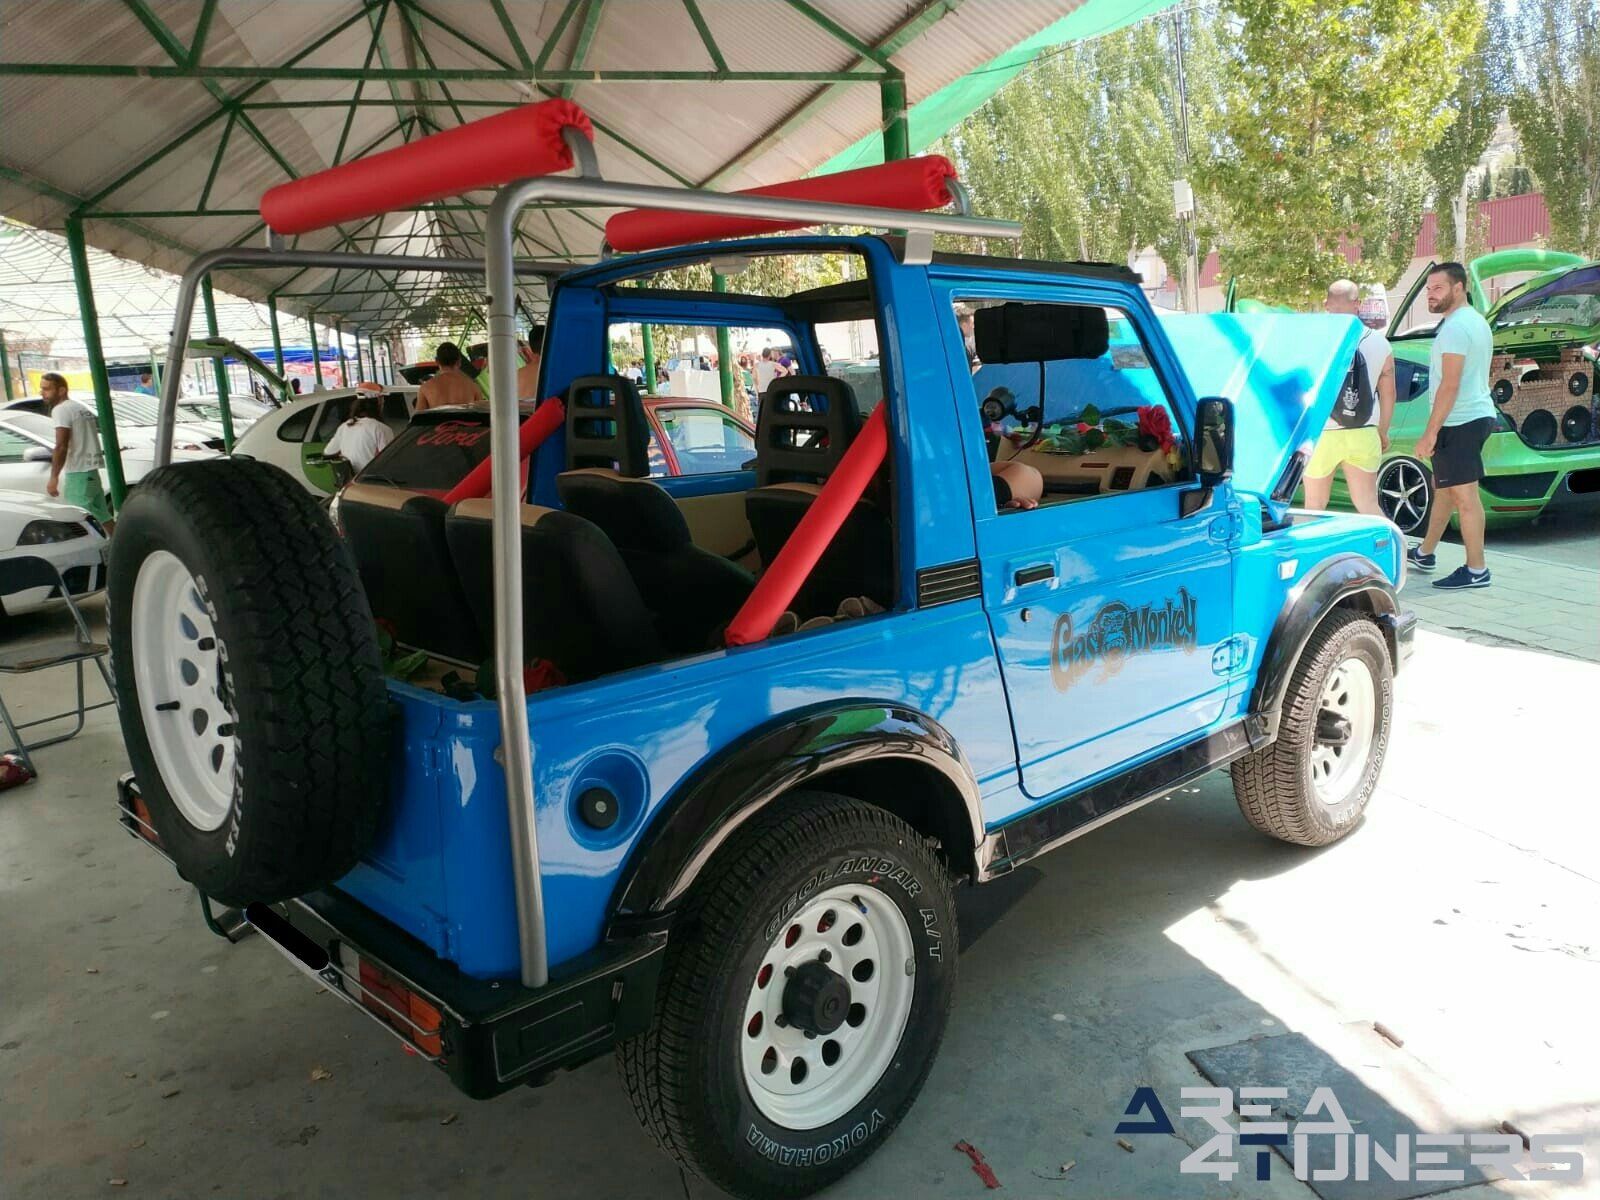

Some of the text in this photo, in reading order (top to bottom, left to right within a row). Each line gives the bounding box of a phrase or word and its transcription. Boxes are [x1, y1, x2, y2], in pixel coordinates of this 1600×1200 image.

[416, 420, 490, 447] Ford
[1052, 586, 1197, 693] Gas Monkey
[765, 856, 944, 963] GEOLANDAR A/T
[746, 1108, 886, 1167] YOKOHAMA
